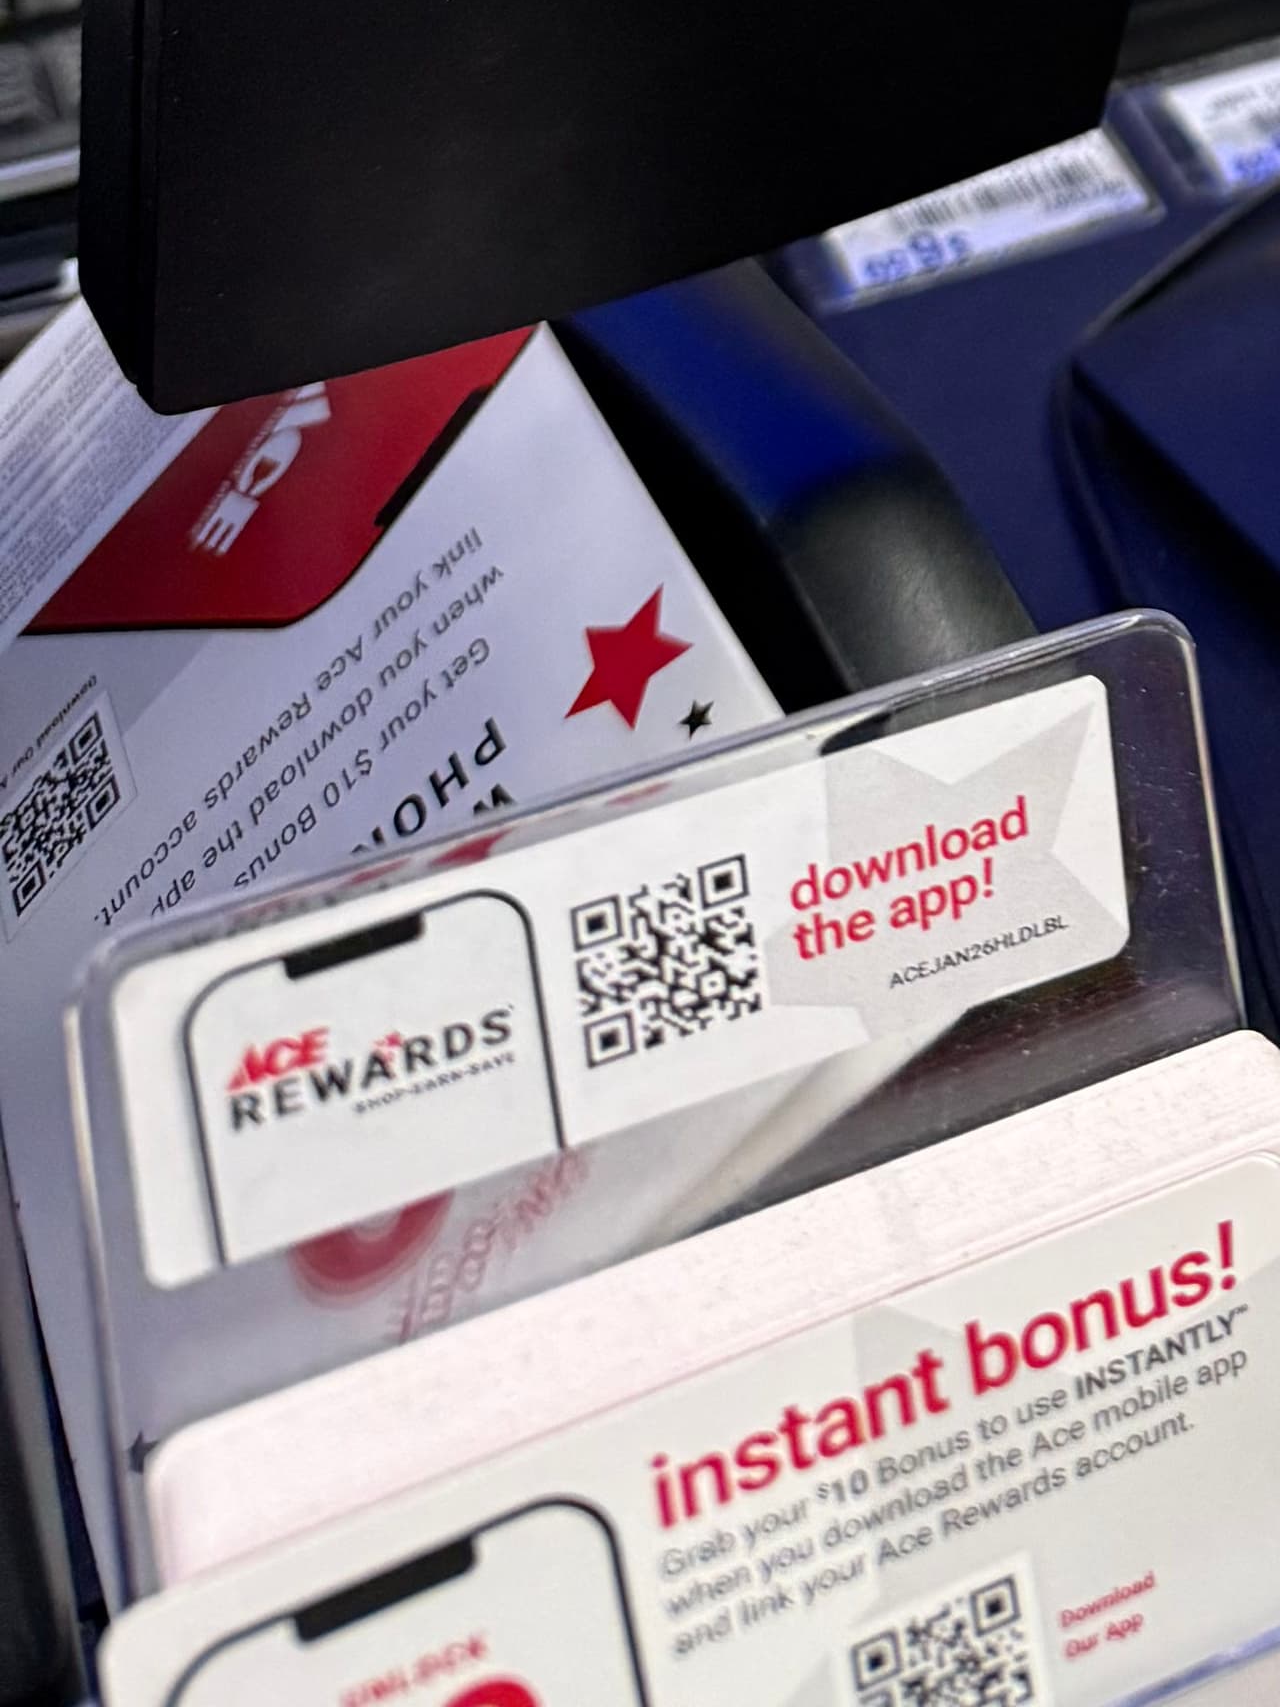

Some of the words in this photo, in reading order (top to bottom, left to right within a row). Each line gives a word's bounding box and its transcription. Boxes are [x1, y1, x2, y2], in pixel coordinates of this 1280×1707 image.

[431, 526, 483, 577] link
[373, 570, 435, 640] your
[432, 565, 504, 638] when
[317, 635, 364, 693] Ace
[378, 627, 429, 690] you
[444, 637, 492, 691] Get
[203, 694, 314, 810] Rewards
[377, 680, 438, 751] your
[248, 689, 375, 827] download
[322, 747, 375, 809] $10
[93, 810, 198, 927] account.
[203, 821, 245, 869] the
[233, 804, 319, 889] Bonus
[789, 793, 1029, 912] download
[793, 907, 877, 961] the
[888, 855, 994, 932] app!
[226, 1025, 331, 1093] ACE
[228, 1006, 513, 1132] REWARDS
[650, 1348, 950, 1529] instant
[963, 1219, 1238, 1397] bonus!
[661, 1529, 737, 1577] Grab
[743, 1497, 809, 1549] your
[876, 1428, 971, 1486] Bonus
[976, 1409, 1008, 1442] to
[1015, 1387, 1069, 1426] use
[667, 1564, 752, 1617] when
[758, 1536, 815, 1586] you
[822, 1463, 970, 1550] download
[975, 1444, 1025, 1483] the
[1031, 1418, 1087, 1460] Ace
[1091, 1372, 1190, 1433] mobile
[1197, 1348, 1249, 1389] app
[673, 1605, 735, 1657] and
[739, 1589, 795, 1628] link
[801, 1553, 866, 1607] your
[876, 1524, 935, 1567] Ace
[940, 1464, 1068, 1538] Rewards
[1074, 1410, 1197, 1480] account.
[1058, 1569, 1158, 1630] Download
[1062, 1633, 1099, 1660] Our
[1104, 1613, 1145, 1645] App
